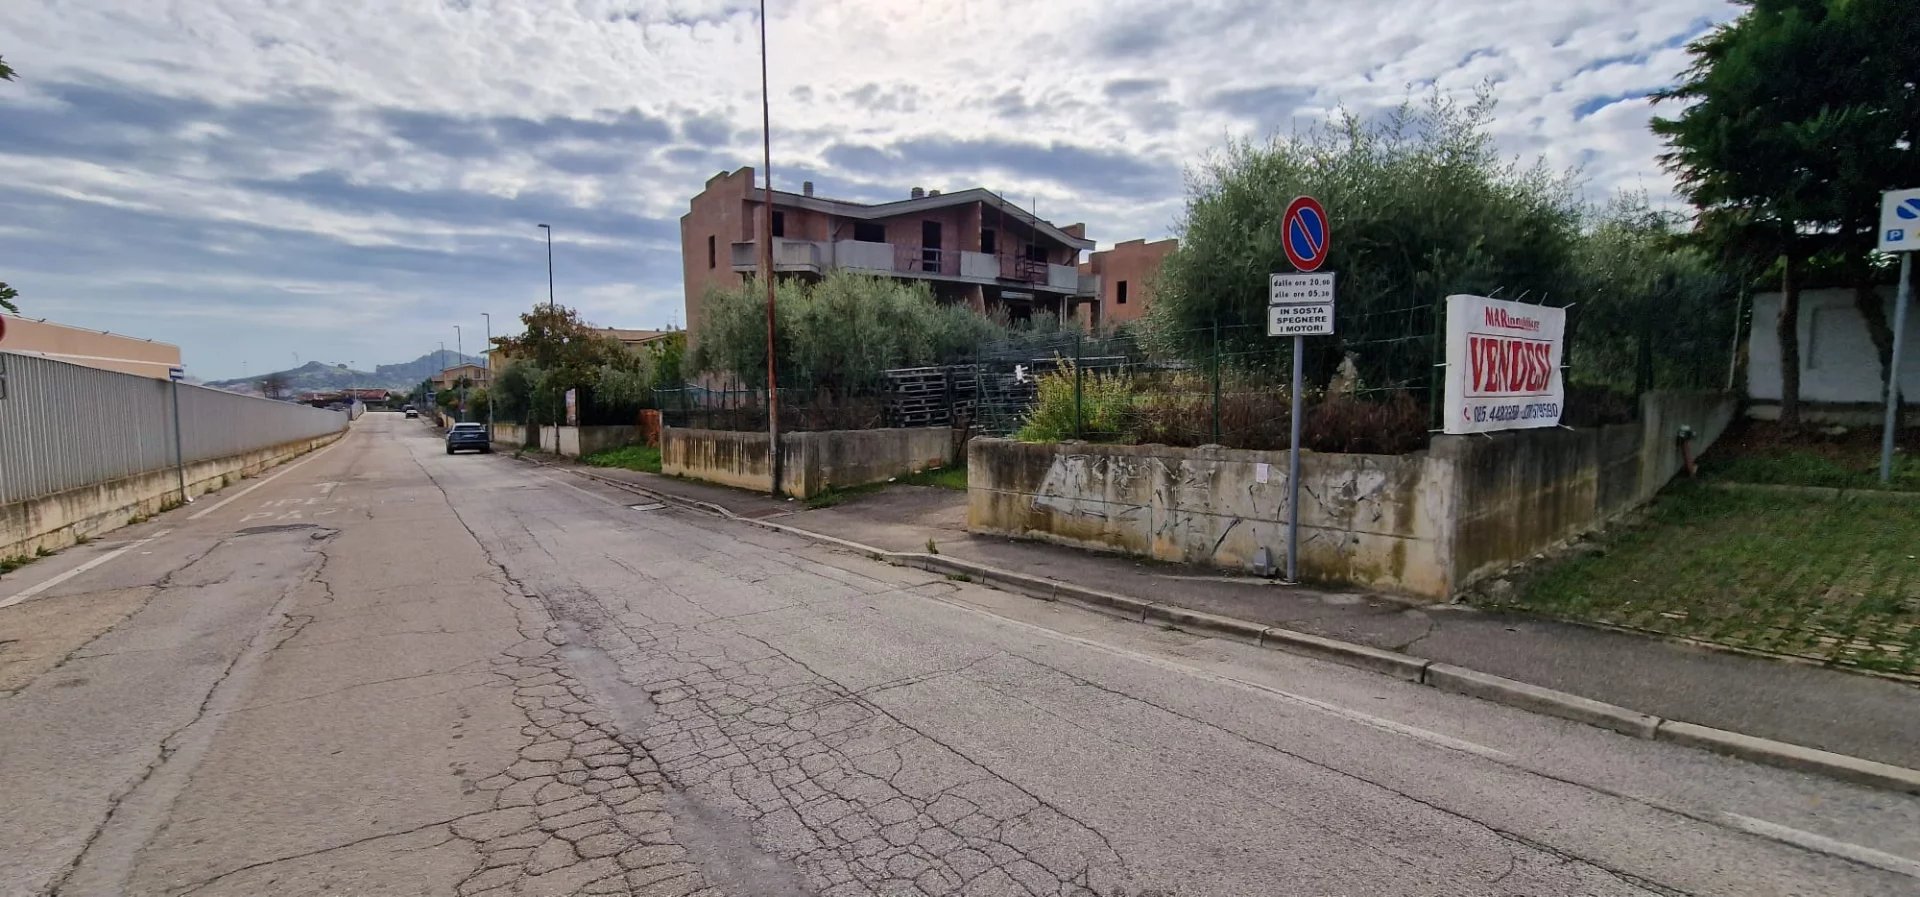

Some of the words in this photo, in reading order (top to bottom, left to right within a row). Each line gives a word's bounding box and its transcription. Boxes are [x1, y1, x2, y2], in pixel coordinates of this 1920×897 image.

[1274, 279, 1292, 287] dalle
[1293, 307, 1324, 315] SOSTA
[1276, 316, 1327, 324] SPEGNERE
[1470, 337, 1552, 392] VENDESI
